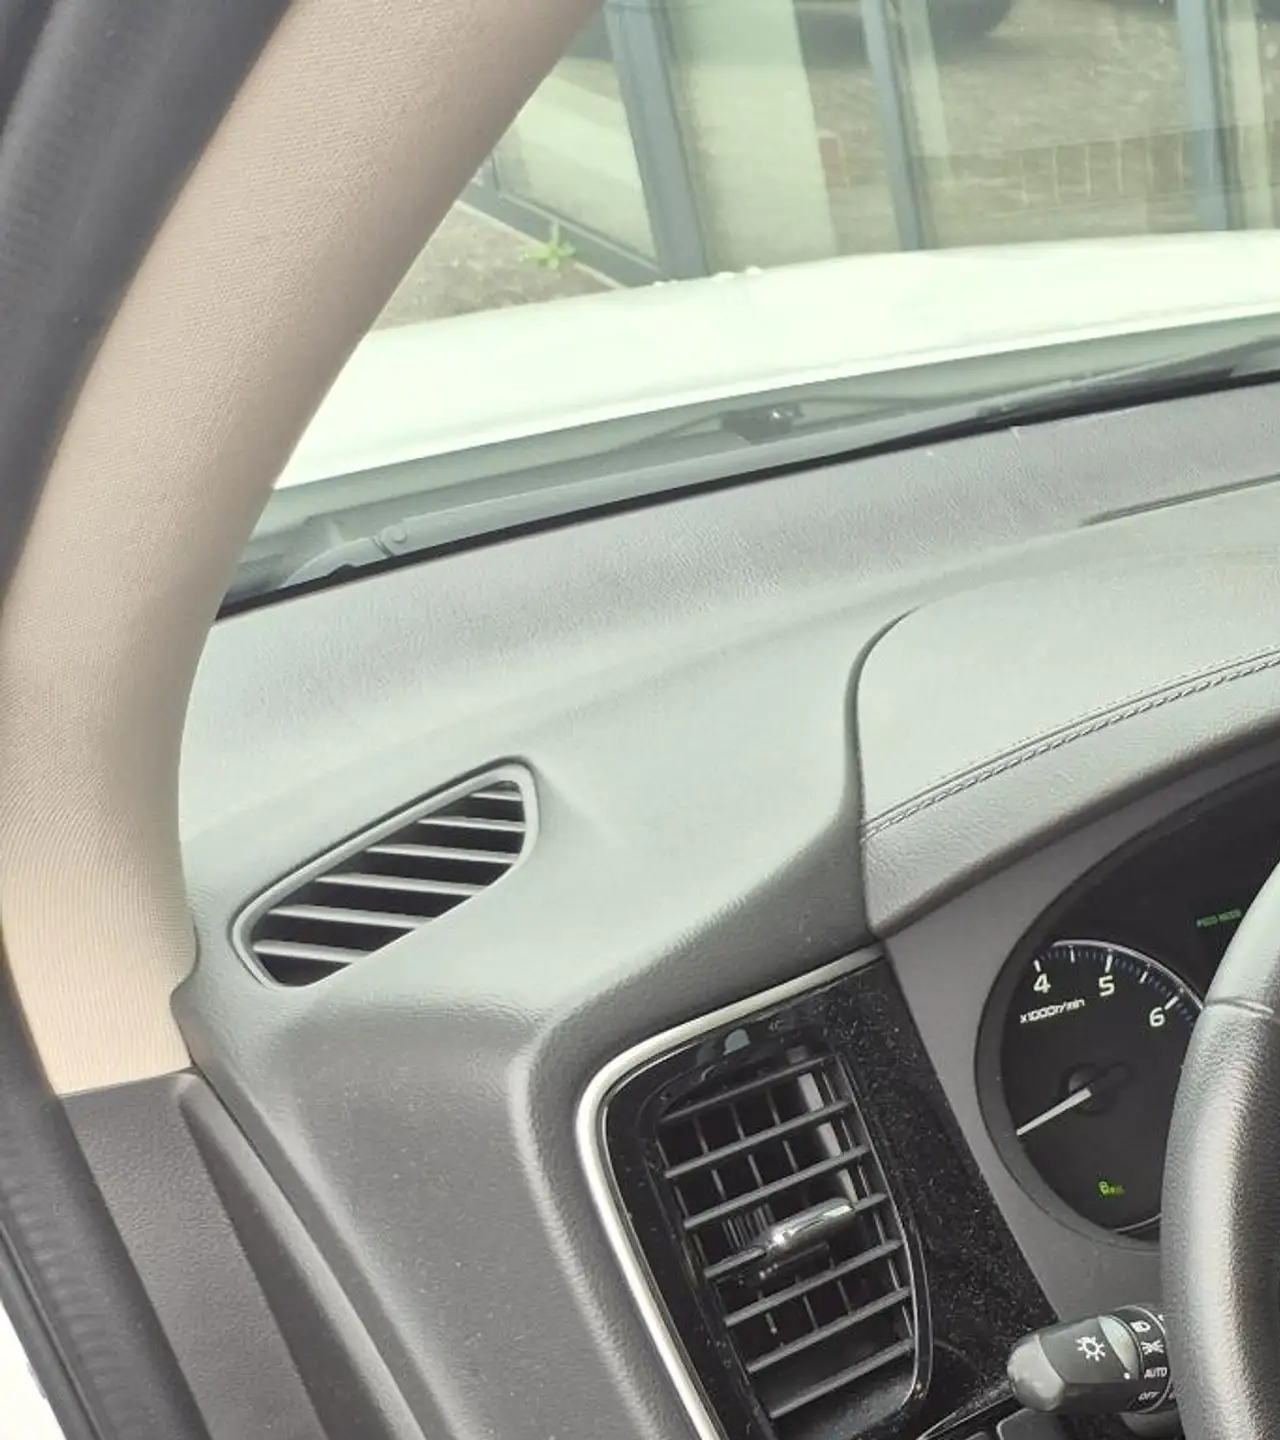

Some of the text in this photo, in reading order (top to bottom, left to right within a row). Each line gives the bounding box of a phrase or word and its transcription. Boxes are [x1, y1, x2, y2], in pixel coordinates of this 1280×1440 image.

[1033, 973, 1051, 994] 4
[1098, 974, 1115, 998] 5
[1149, 1006, 1166, 1028] 6
[1143, 1366, 1169, 1380] AUTO
